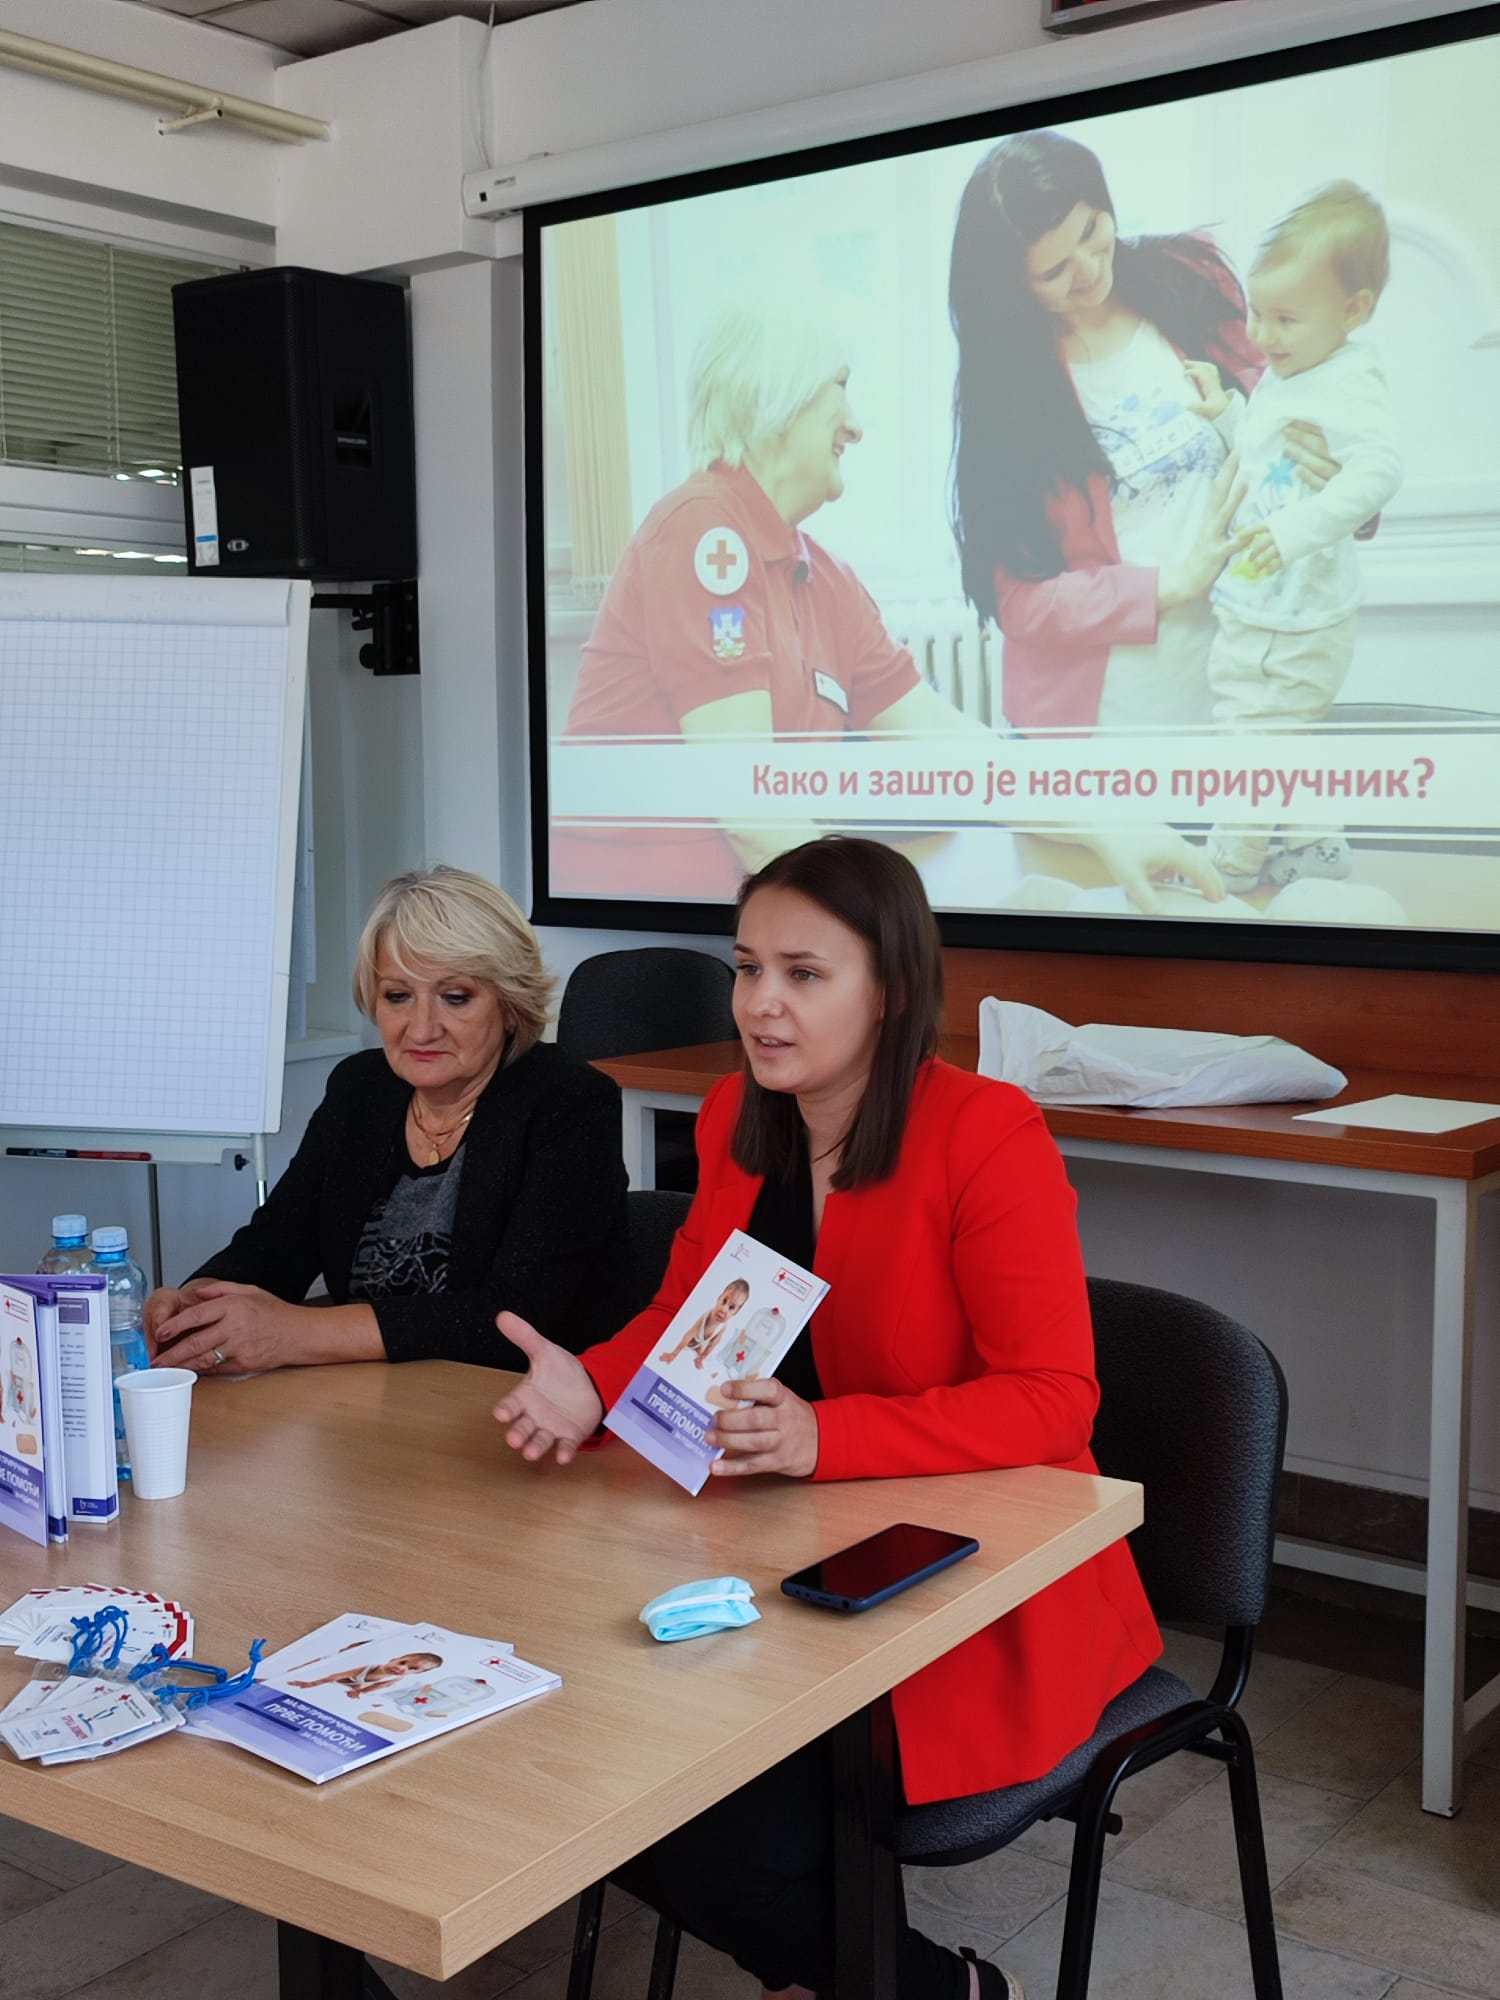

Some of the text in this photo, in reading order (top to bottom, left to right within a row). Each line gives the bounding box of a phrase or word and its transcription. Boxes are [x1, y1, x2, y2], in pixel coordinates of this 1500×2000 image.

[752, 757, 1436, 807] Како и зашто је настао приручник?
[648, 1393, 674, 1419] ПРВЕ
[263, 1703, 367, 1752] ПРВЕ ПОМОЋИ
